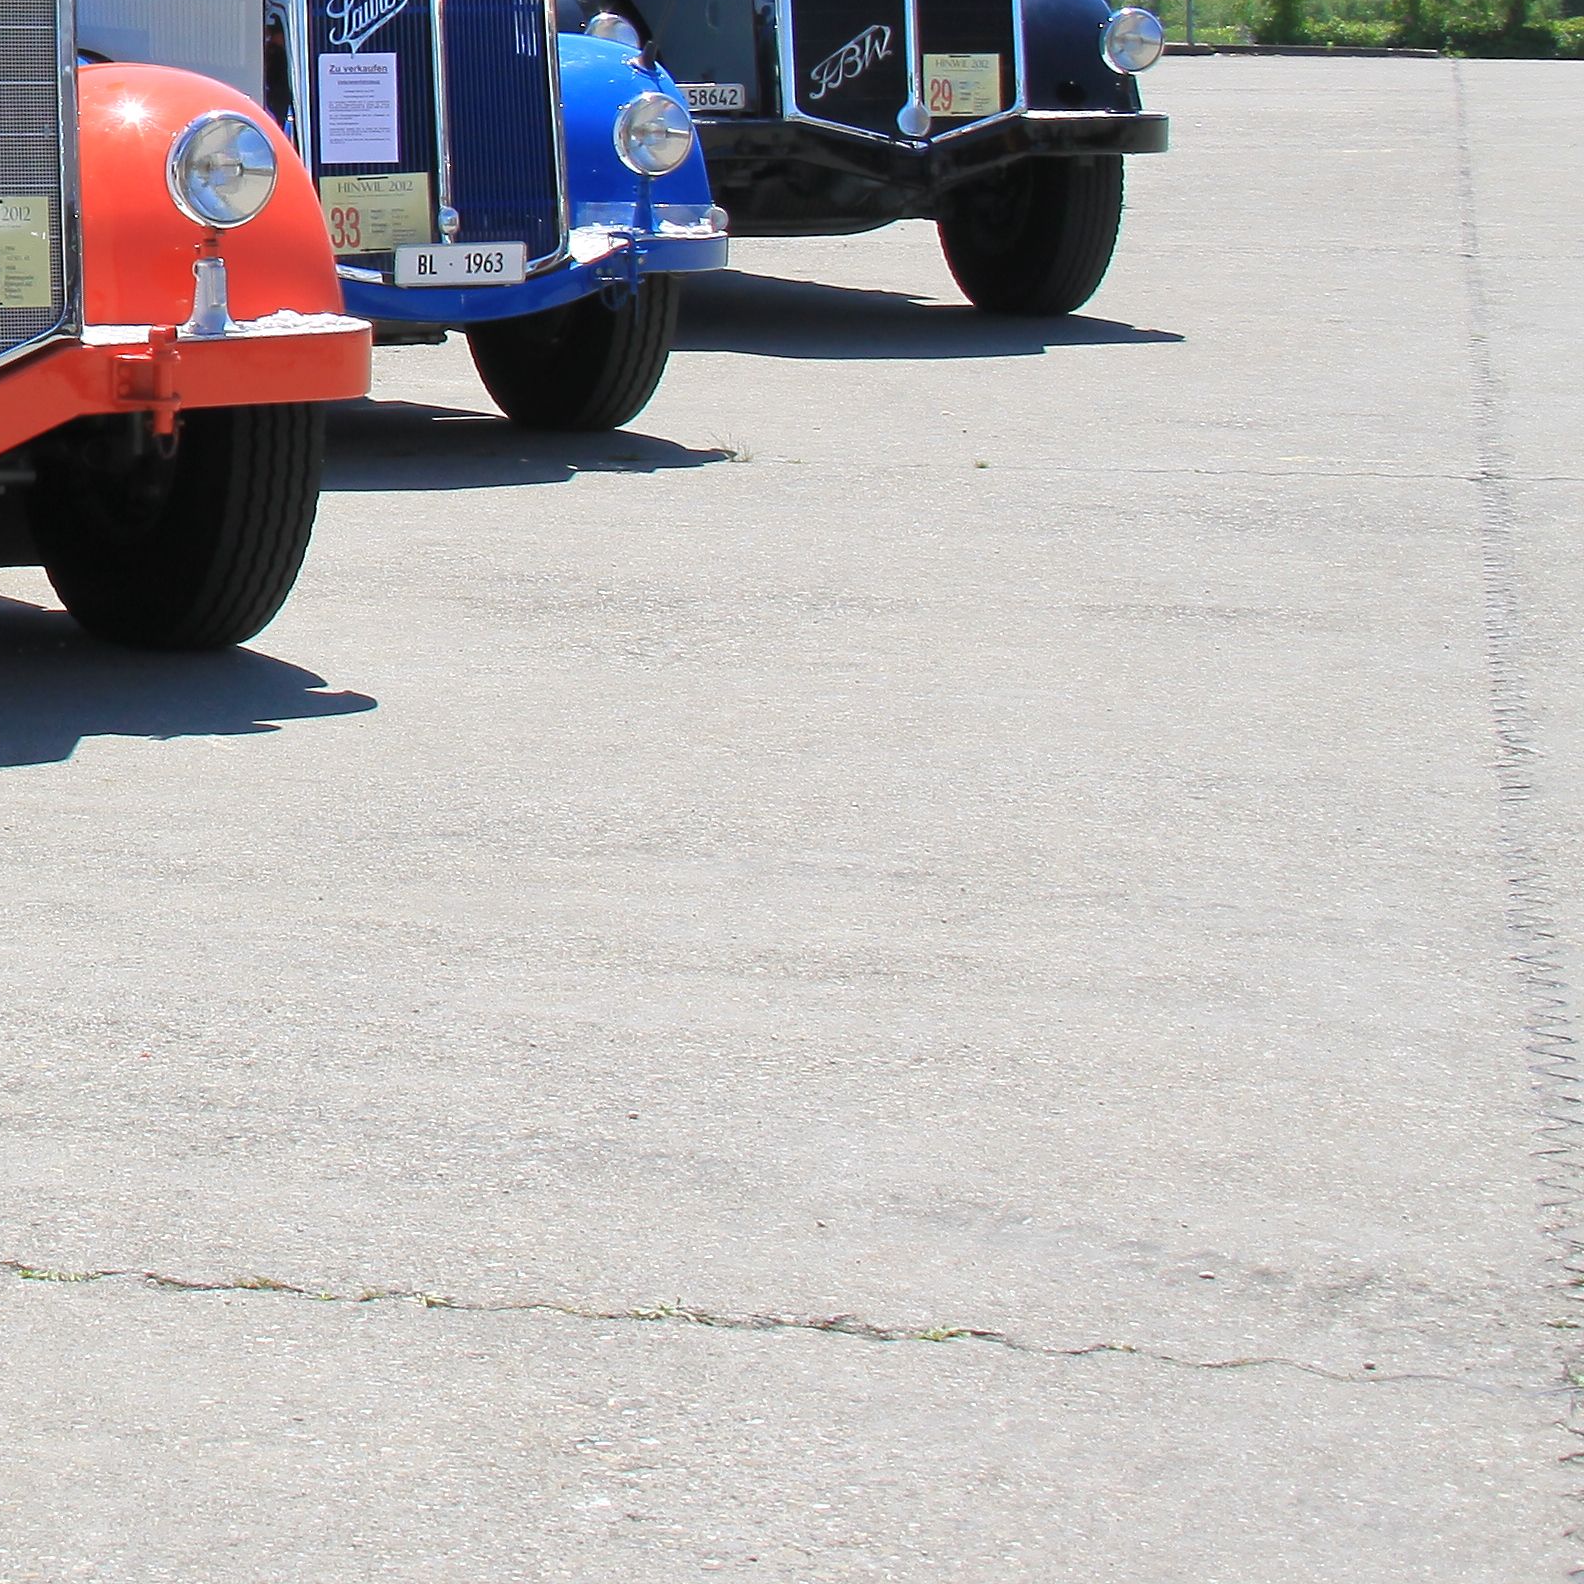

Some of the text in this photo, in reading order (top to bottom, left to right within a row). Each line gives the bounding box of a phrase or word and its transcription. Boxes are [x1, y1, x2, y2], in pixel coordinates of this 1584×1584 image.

[329, 63, 388, 74] Zu verkaufen
[809, 24, 893, 100] FBW
[688, 88, 739, 106] 58642
[930, 78, 953, 112] 29
[337, 179, 414, 194] HINWIL 2012
[1, 205, 32, 222] 2012
[331, 206, 361, 249] 33
[417, 252, 504, 275] BL 1963
